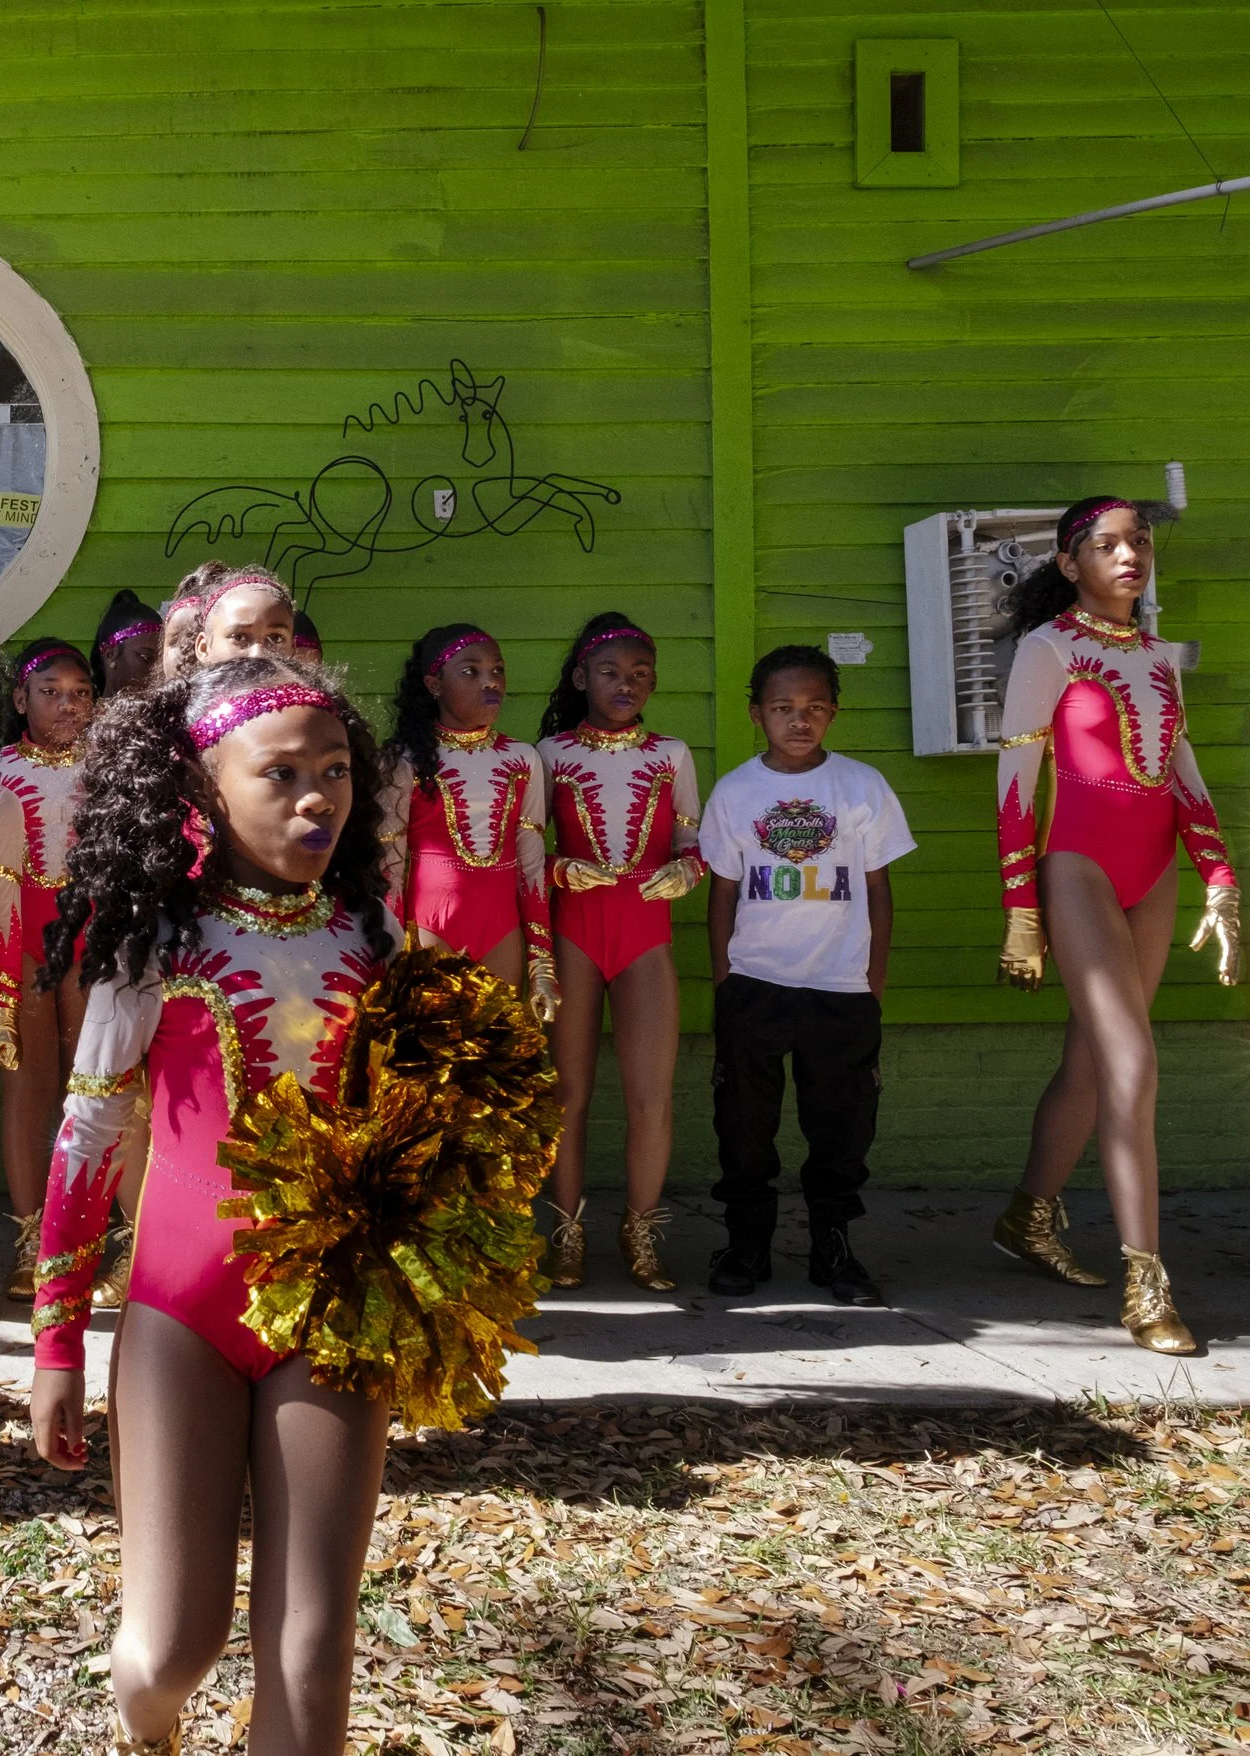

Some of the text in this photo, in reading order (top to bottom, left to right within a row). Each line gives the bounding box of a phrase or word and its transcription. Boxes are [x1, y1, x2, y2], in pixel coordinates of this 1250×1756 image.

[1, 498, 39, 512] FEST
[766, 817, 824, 831] Satin Dolls
[777, 838, 814, 855] Gras
[748, 864, 851, 901] NOLA
